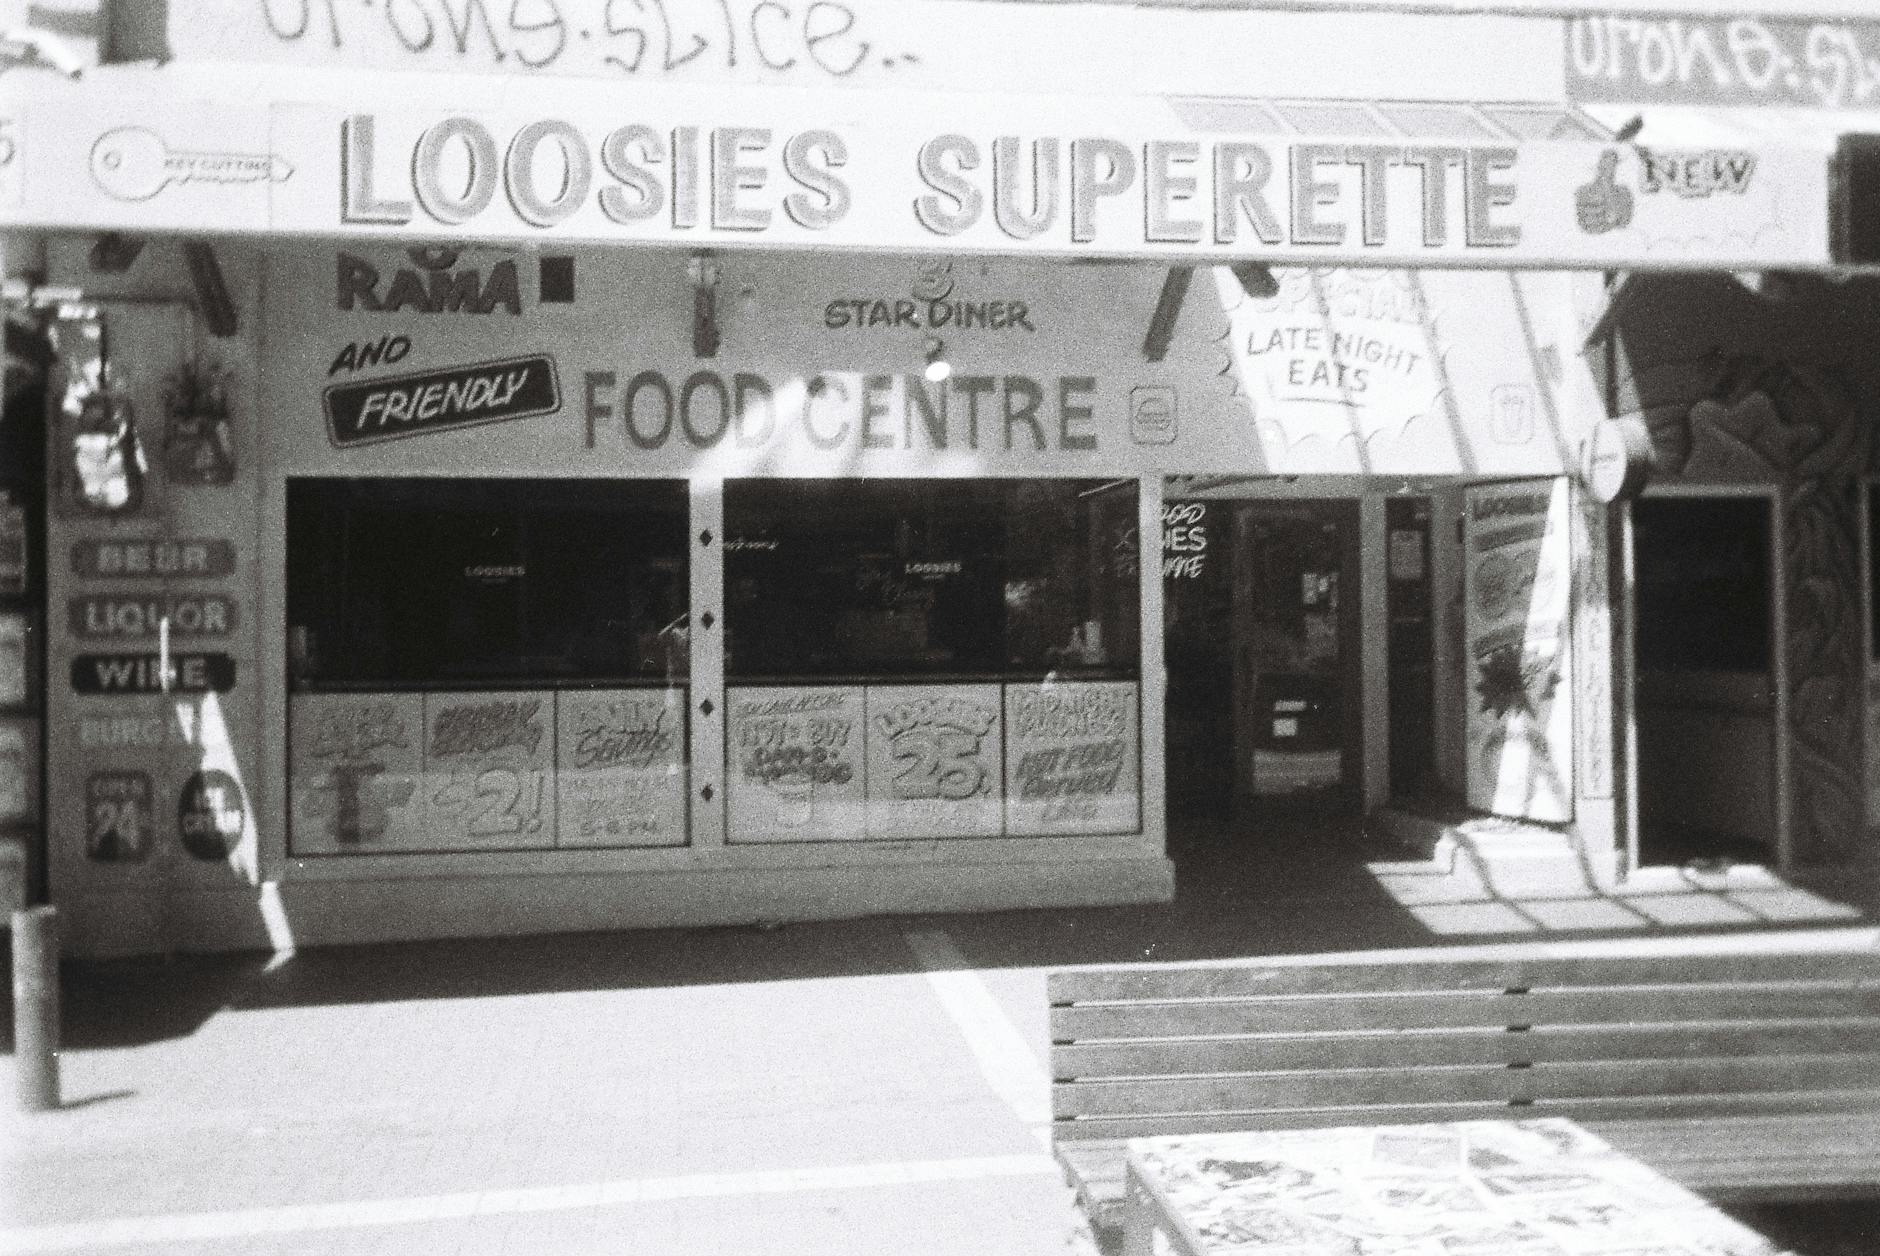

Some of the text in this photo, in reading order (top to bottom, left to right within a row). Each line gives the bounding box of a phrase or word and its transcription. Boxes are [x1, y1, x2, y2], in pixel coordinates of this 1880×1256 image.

[339, 113, 1521, 248] LOOSIES SUPERETTE
[1638, 150, 1758, 198] NEW
[337, 251, 521, 315] RAMA
[823, 298, 1037, 333] STAR DINER
[329, 335, 412, 377] AND
[1245, 326, 1423, 377] LATE NIGHT
[1287, 357, 1371, 395] EATS
[355, 367, 530, 430] FRIENDLY
[584, 370, 1100, 453] FOOD CENTRE
